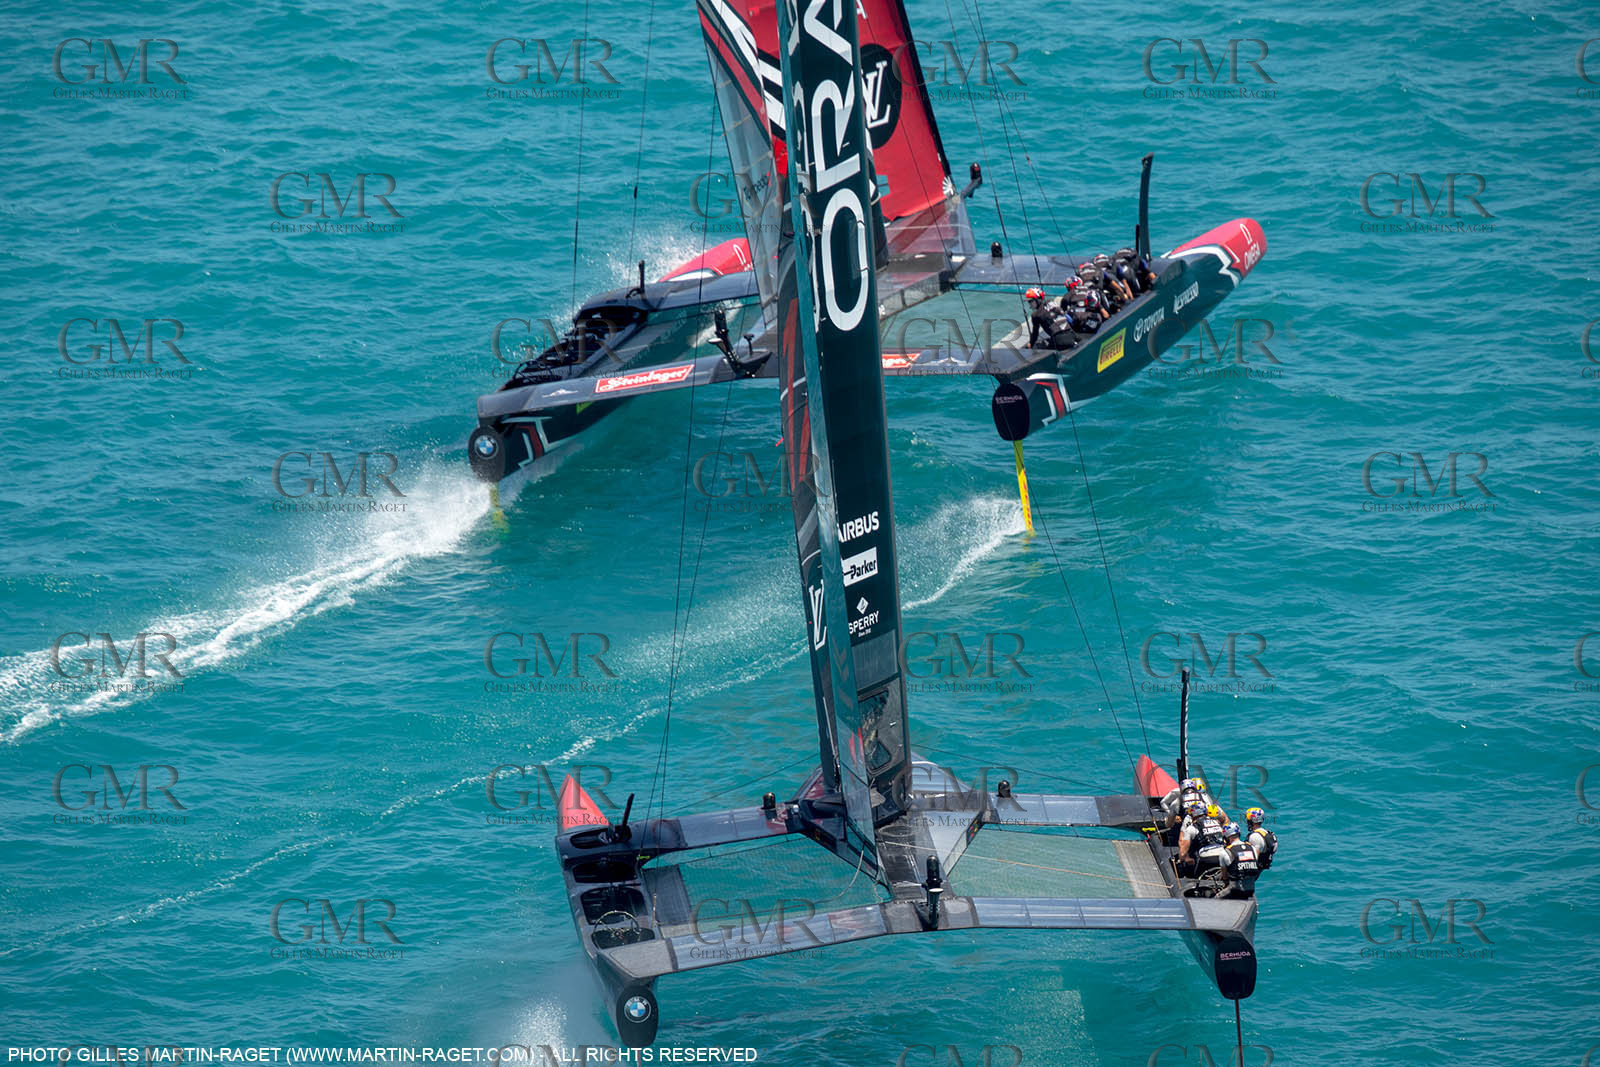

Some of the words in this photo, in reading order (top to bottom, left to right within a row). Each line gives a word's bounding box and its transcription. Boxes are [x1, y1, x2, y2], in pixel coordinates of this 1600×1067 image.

[1143, 306, 1165, 335] TOYOTA
[850, 559, 877, 580] Parker
[848, 610, 880, 635] SPERRY
